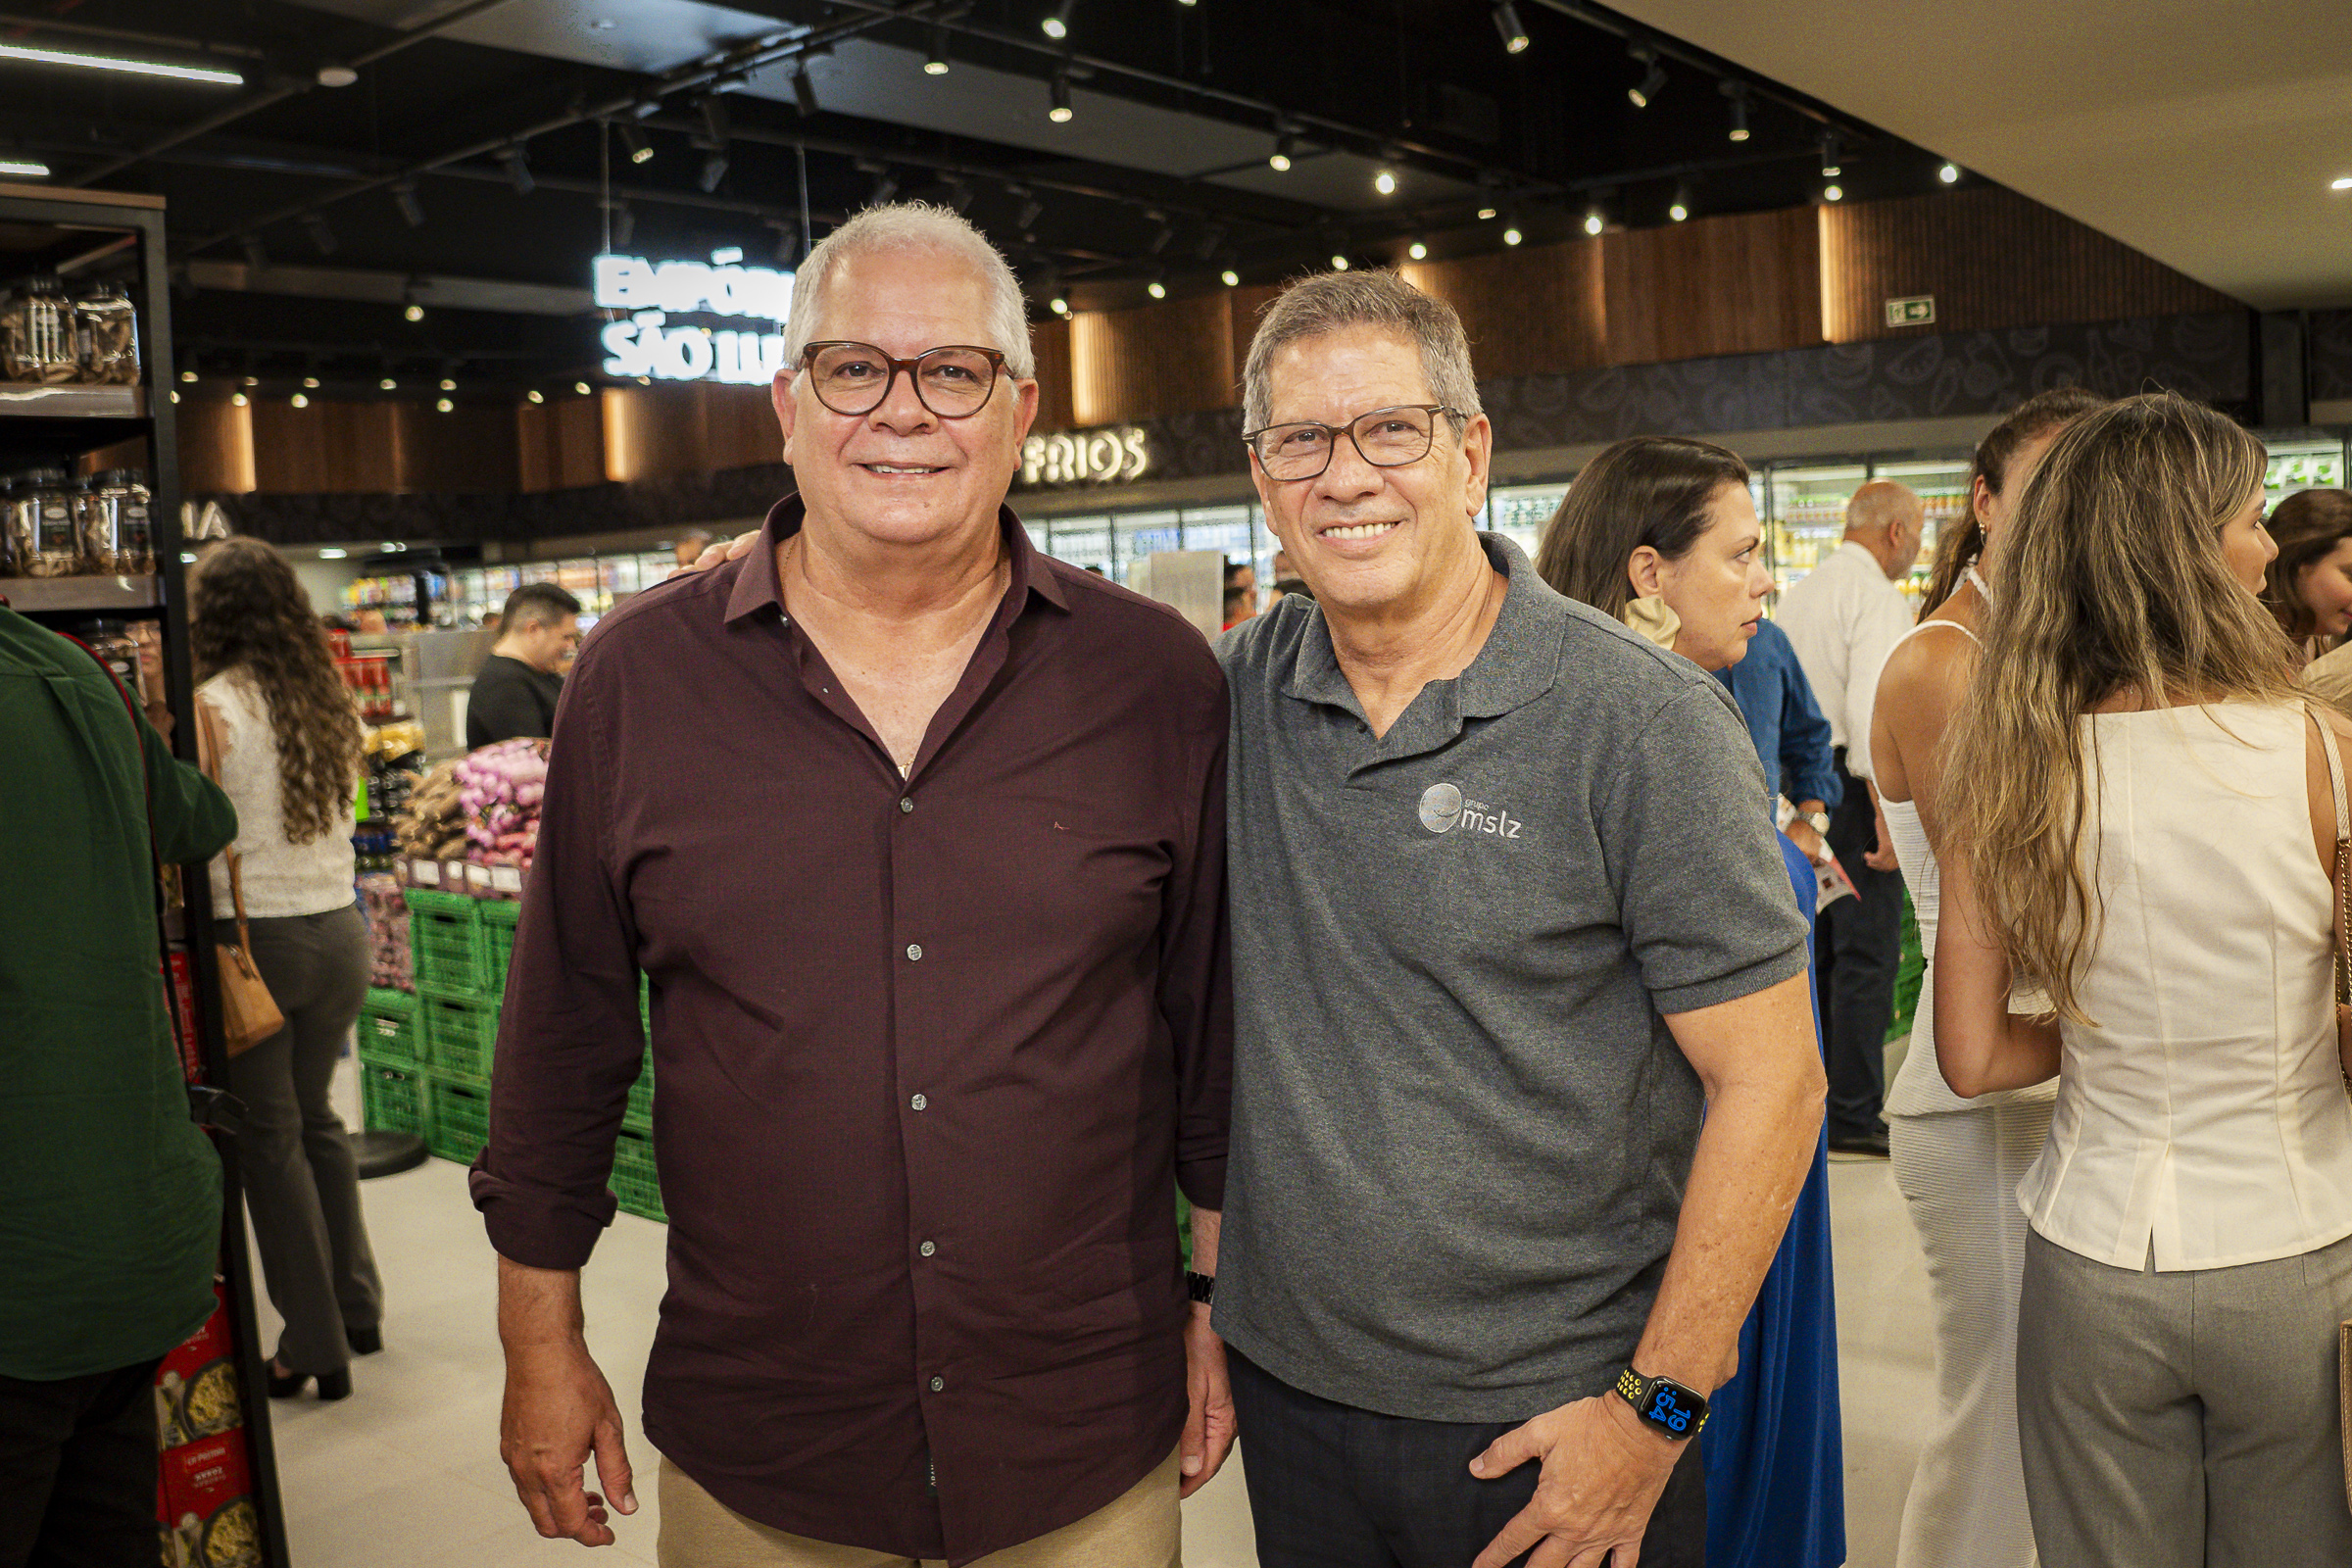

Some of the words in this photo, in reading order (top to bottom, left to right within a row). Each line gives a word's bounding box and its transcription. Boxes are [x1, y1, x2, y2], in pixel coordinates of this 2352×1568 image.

[601, 310, 713, 380] SÃO
[1024, 428, 1147, 483] FRIOS
[1464, 798, 1490, 811] grupo
[1460, 808, 1522, 840] mslz
[1667, 1408, 1691, 1432] 19
